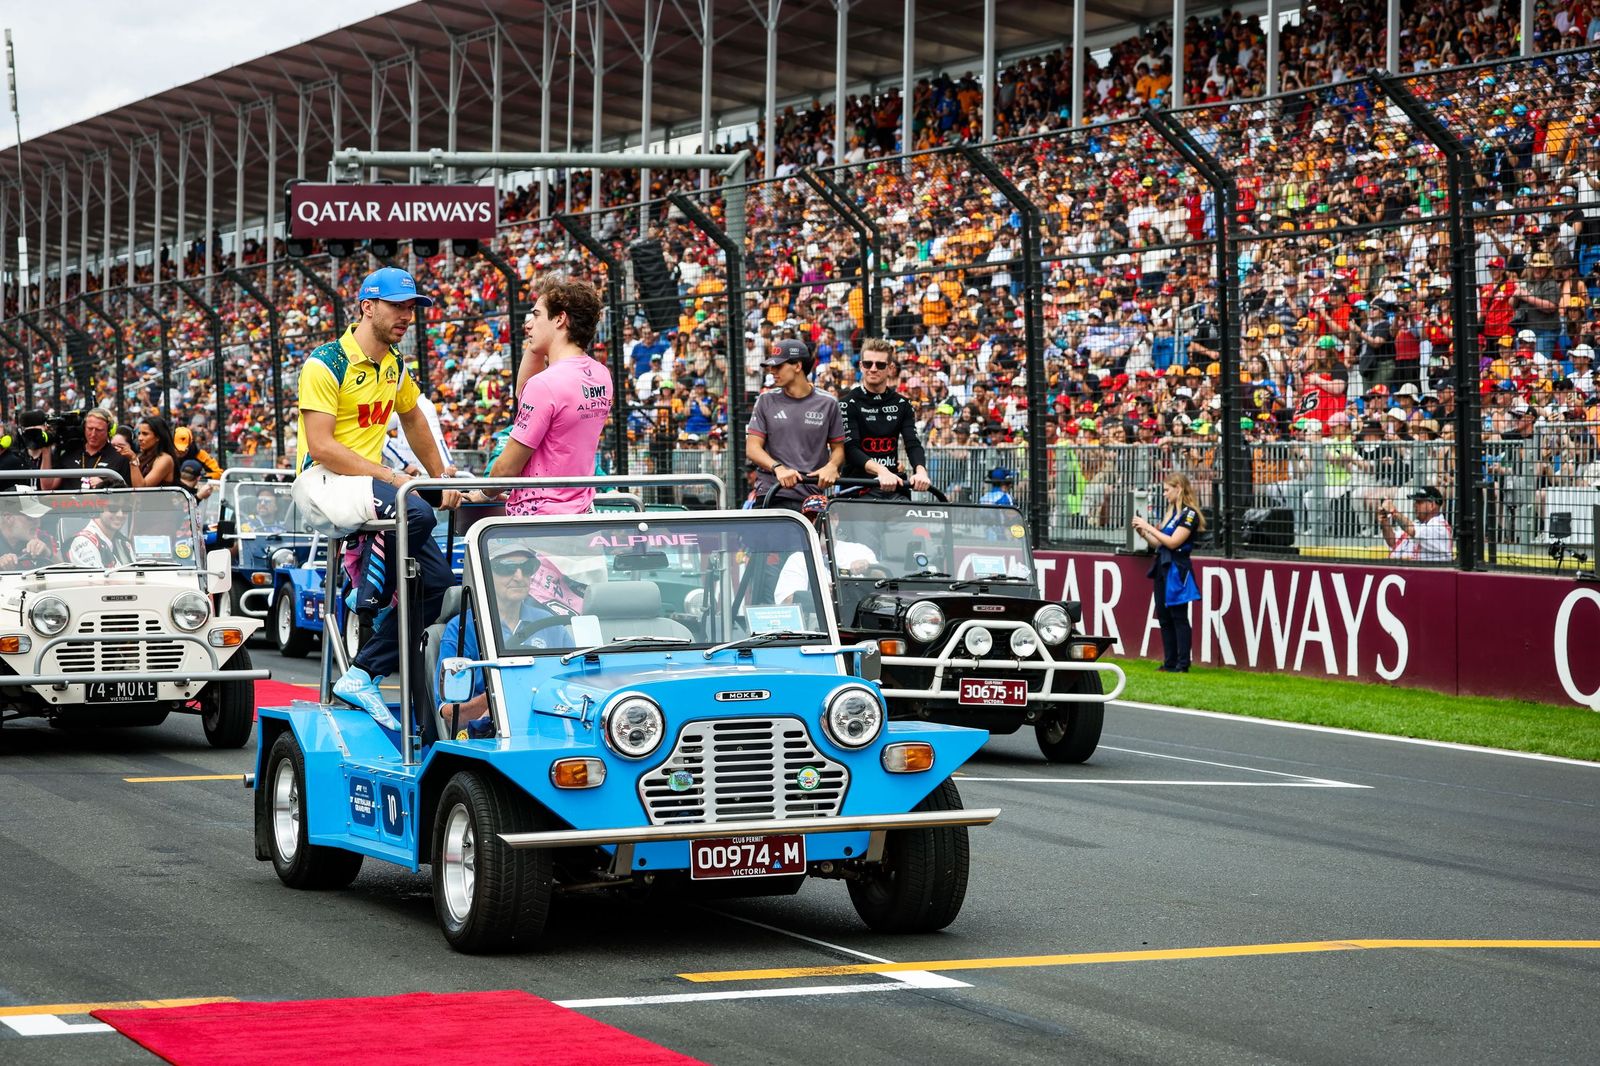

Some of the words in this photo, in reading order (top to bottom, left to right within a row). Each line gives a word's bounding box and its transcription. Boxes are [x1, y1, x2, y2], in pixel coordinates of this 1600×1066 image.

[297, 201, 382, 226] QATAR
[387, 202, 492, 223] AIRWAYS
[590, 385, 606, 398] BWT
[577, 400, 612, 411] ALPINE
[905, 509, 949, 519] AUDI
[589, 533, 699, 547] ALPINE
[732, 867, 767, 876] VICTORIA
